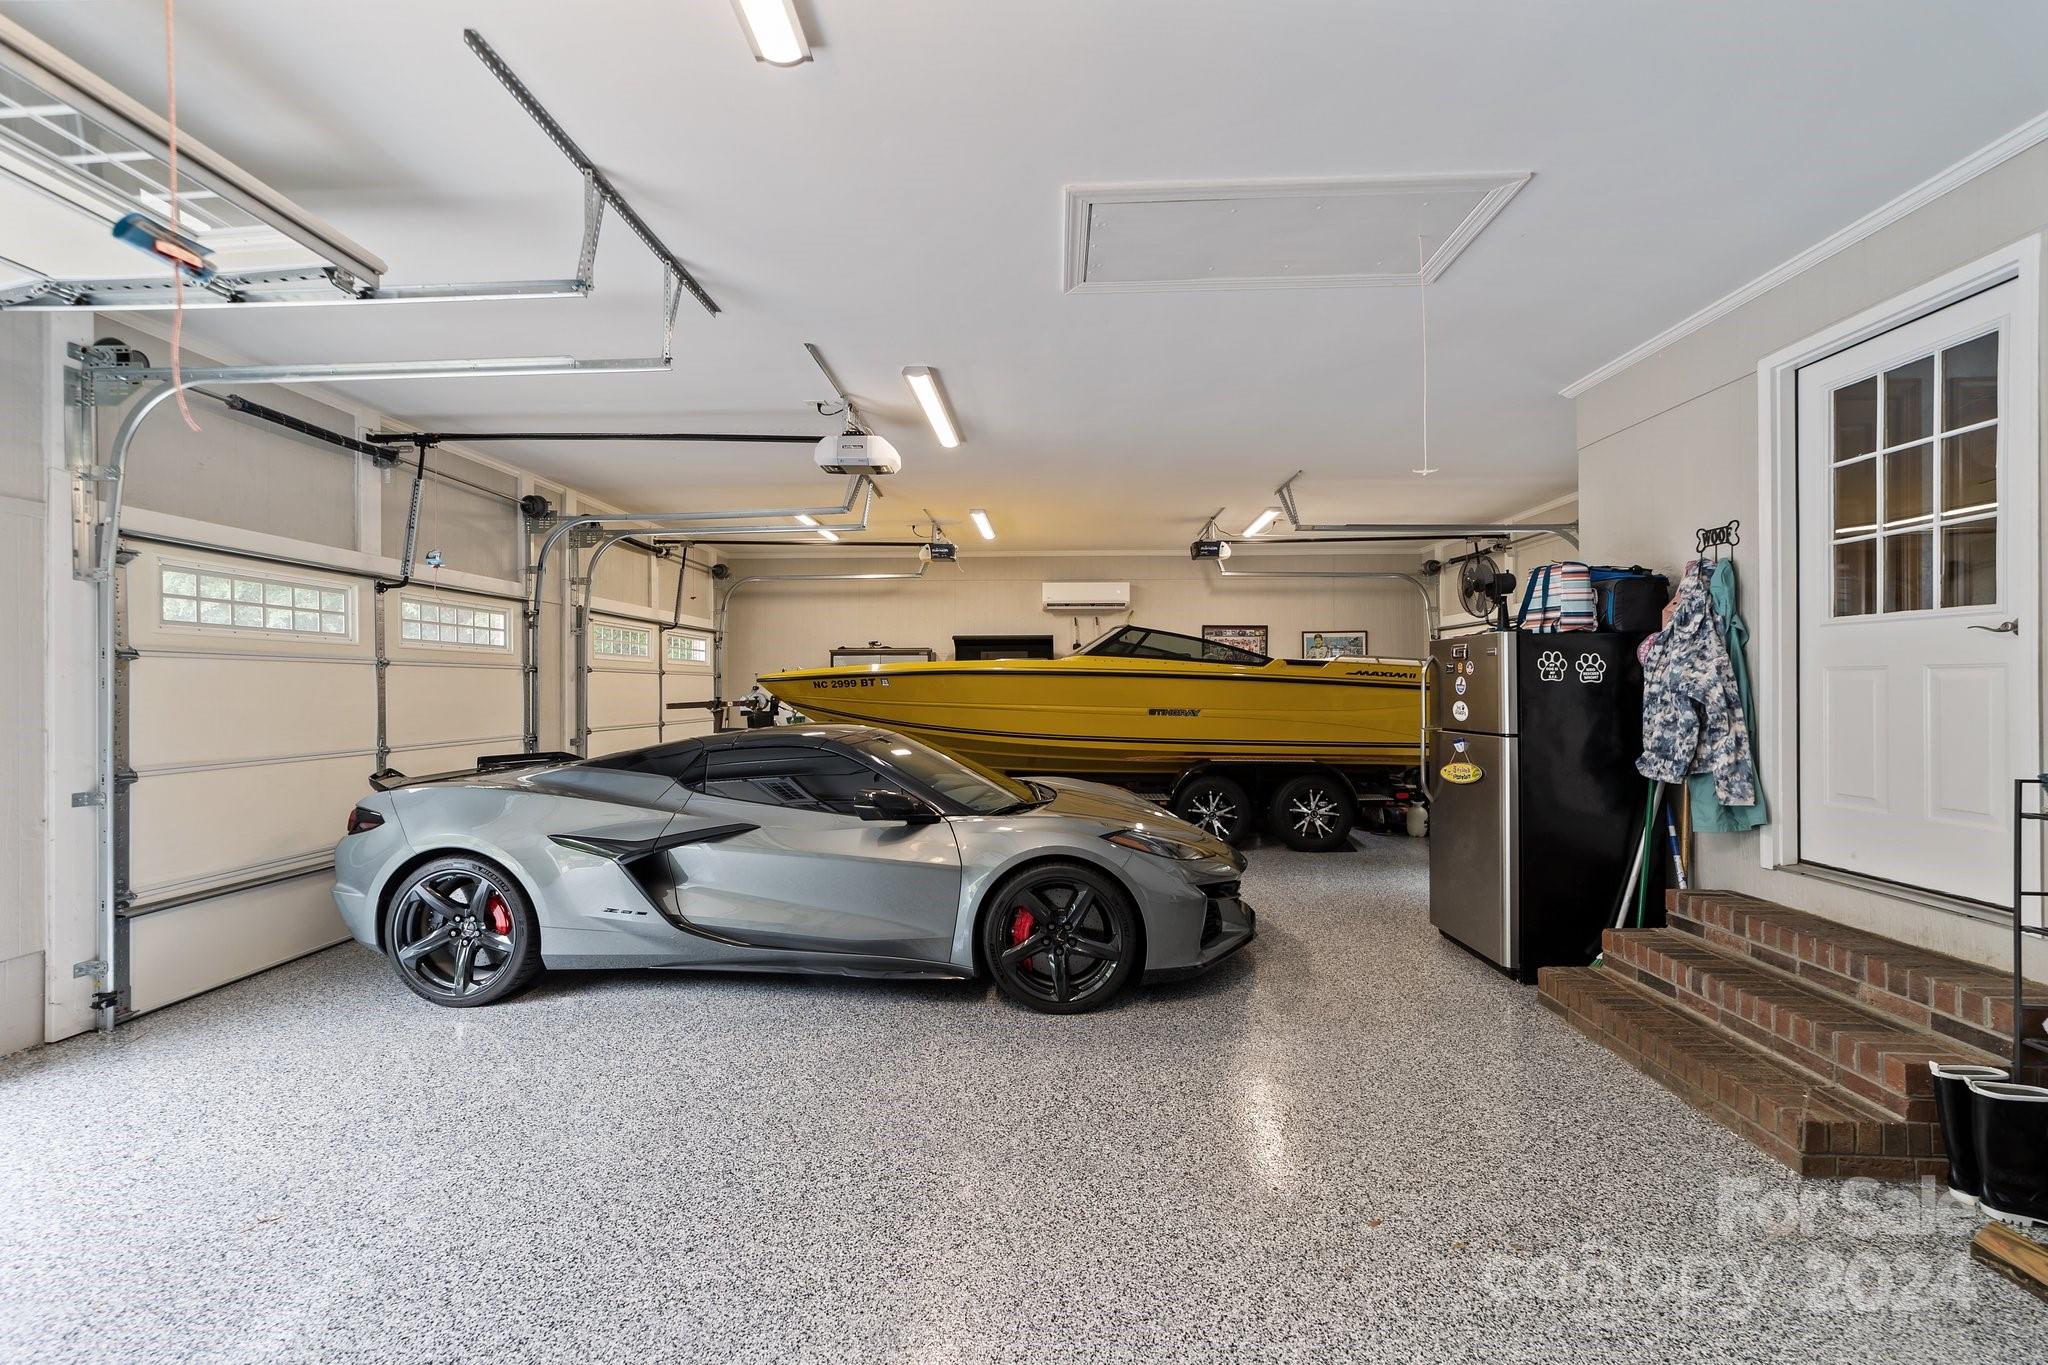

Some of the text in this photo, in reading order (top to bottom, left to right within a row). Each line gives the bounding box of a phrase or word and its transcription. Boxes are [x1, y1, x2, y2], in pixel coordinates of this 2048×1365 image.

[1702, 527, 1732, 546] WOOF
[813, 680, 829, 689] NC
[831, 679, 857, 688] 2999
[860, 678, 876, 687] BT
